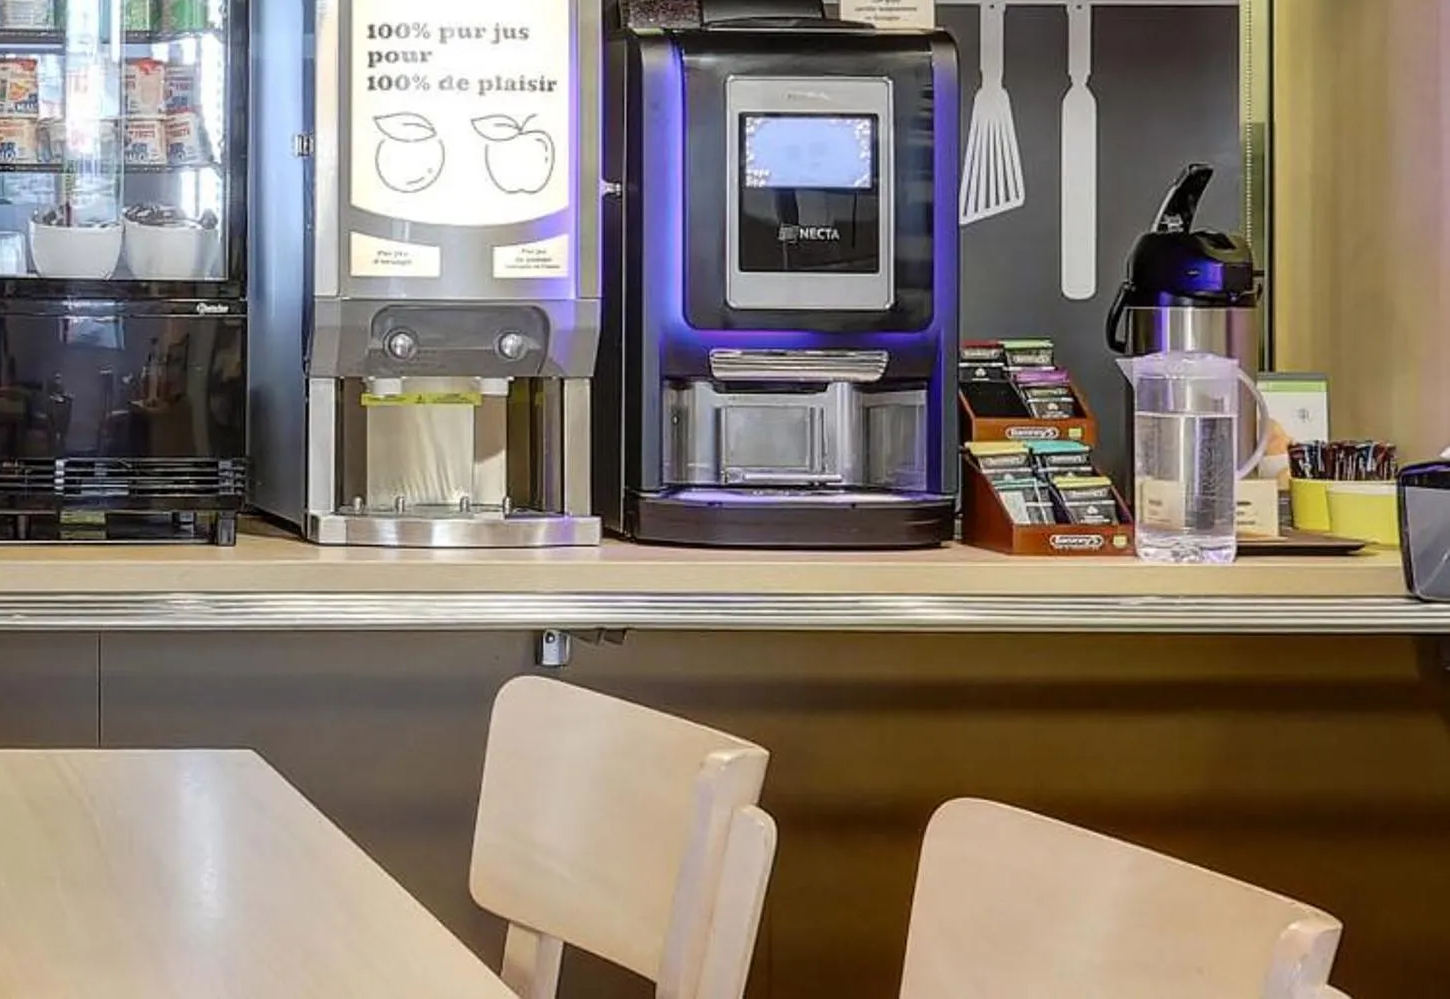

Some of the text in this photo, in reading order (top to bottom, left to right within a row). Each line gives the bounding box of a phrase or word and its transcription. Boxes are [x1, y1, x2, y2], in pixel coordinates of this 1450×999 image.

[366, 22, 530, 45] 100% pur jus
[367, 50, 433, 69] pour
[366, 73, 558, 97] 100% de plaisir
[799, 226, 840, 240] NECTA
